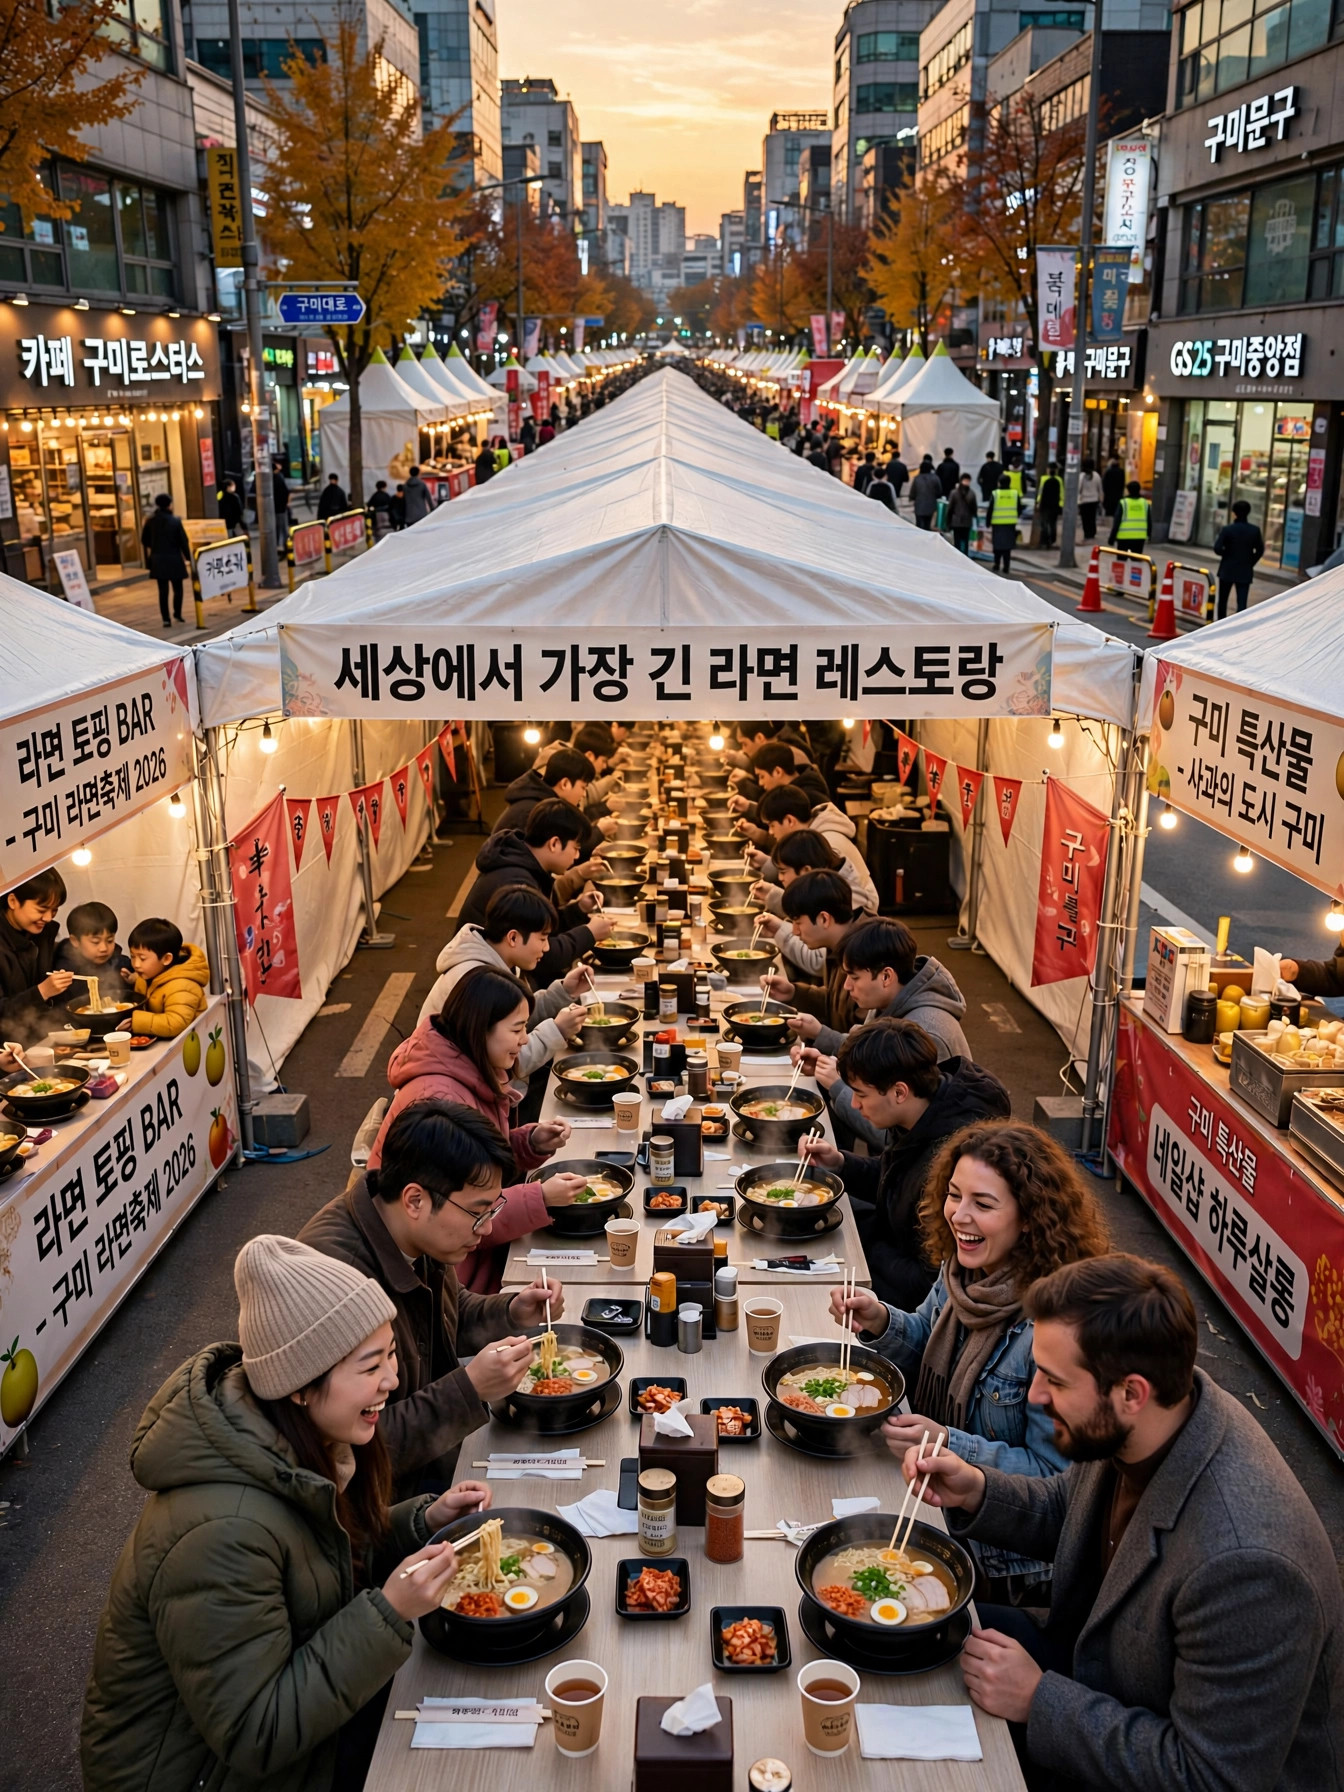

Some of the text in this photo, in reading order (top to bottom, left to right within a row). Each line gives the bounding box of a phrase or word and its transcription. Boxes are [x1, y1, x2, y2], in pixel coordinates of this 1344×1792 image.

[1204, 86, 1296, 164] 구미문구
[296, 297, 348, 313] 구미대로
[21, 334, 75, 387] 카페
[83, 337, 205, 387] 구미로스터스
[1084, 346, 1131, 379] 구미문구
[1170, 333, 1303, 378] GS25 구미중앙점
[334, 642, 1004, 702] 세상에서 가장 긴 라면 레스토랑
[16, 692, 156, 789] 라면 토핑 BAR
[1188, 693, 1314, 795] 구미 특산물
[22, 794, 61, 853] 구미
[65, 761, 131, 828] 라면축제
[134, 746, 167, 794] 2026
[1187, 757, 1236, 818] 사과의
[1237, 780, 1277, 840] 도시
[1281, 800, 1325, 866] 구미
[33, 1077, 183, 1262] 라면 토핑 BAR
[1187, 1095, 1258, 1194] 구미 특산물
[52, 1249, 94, 1328] 구미
[95, 1168, 162, 1273] 라면축제
[163, 1132, 197, 1200] 2026
[1153, 1123, 1297, 1329] 네일샵 하루살롱
